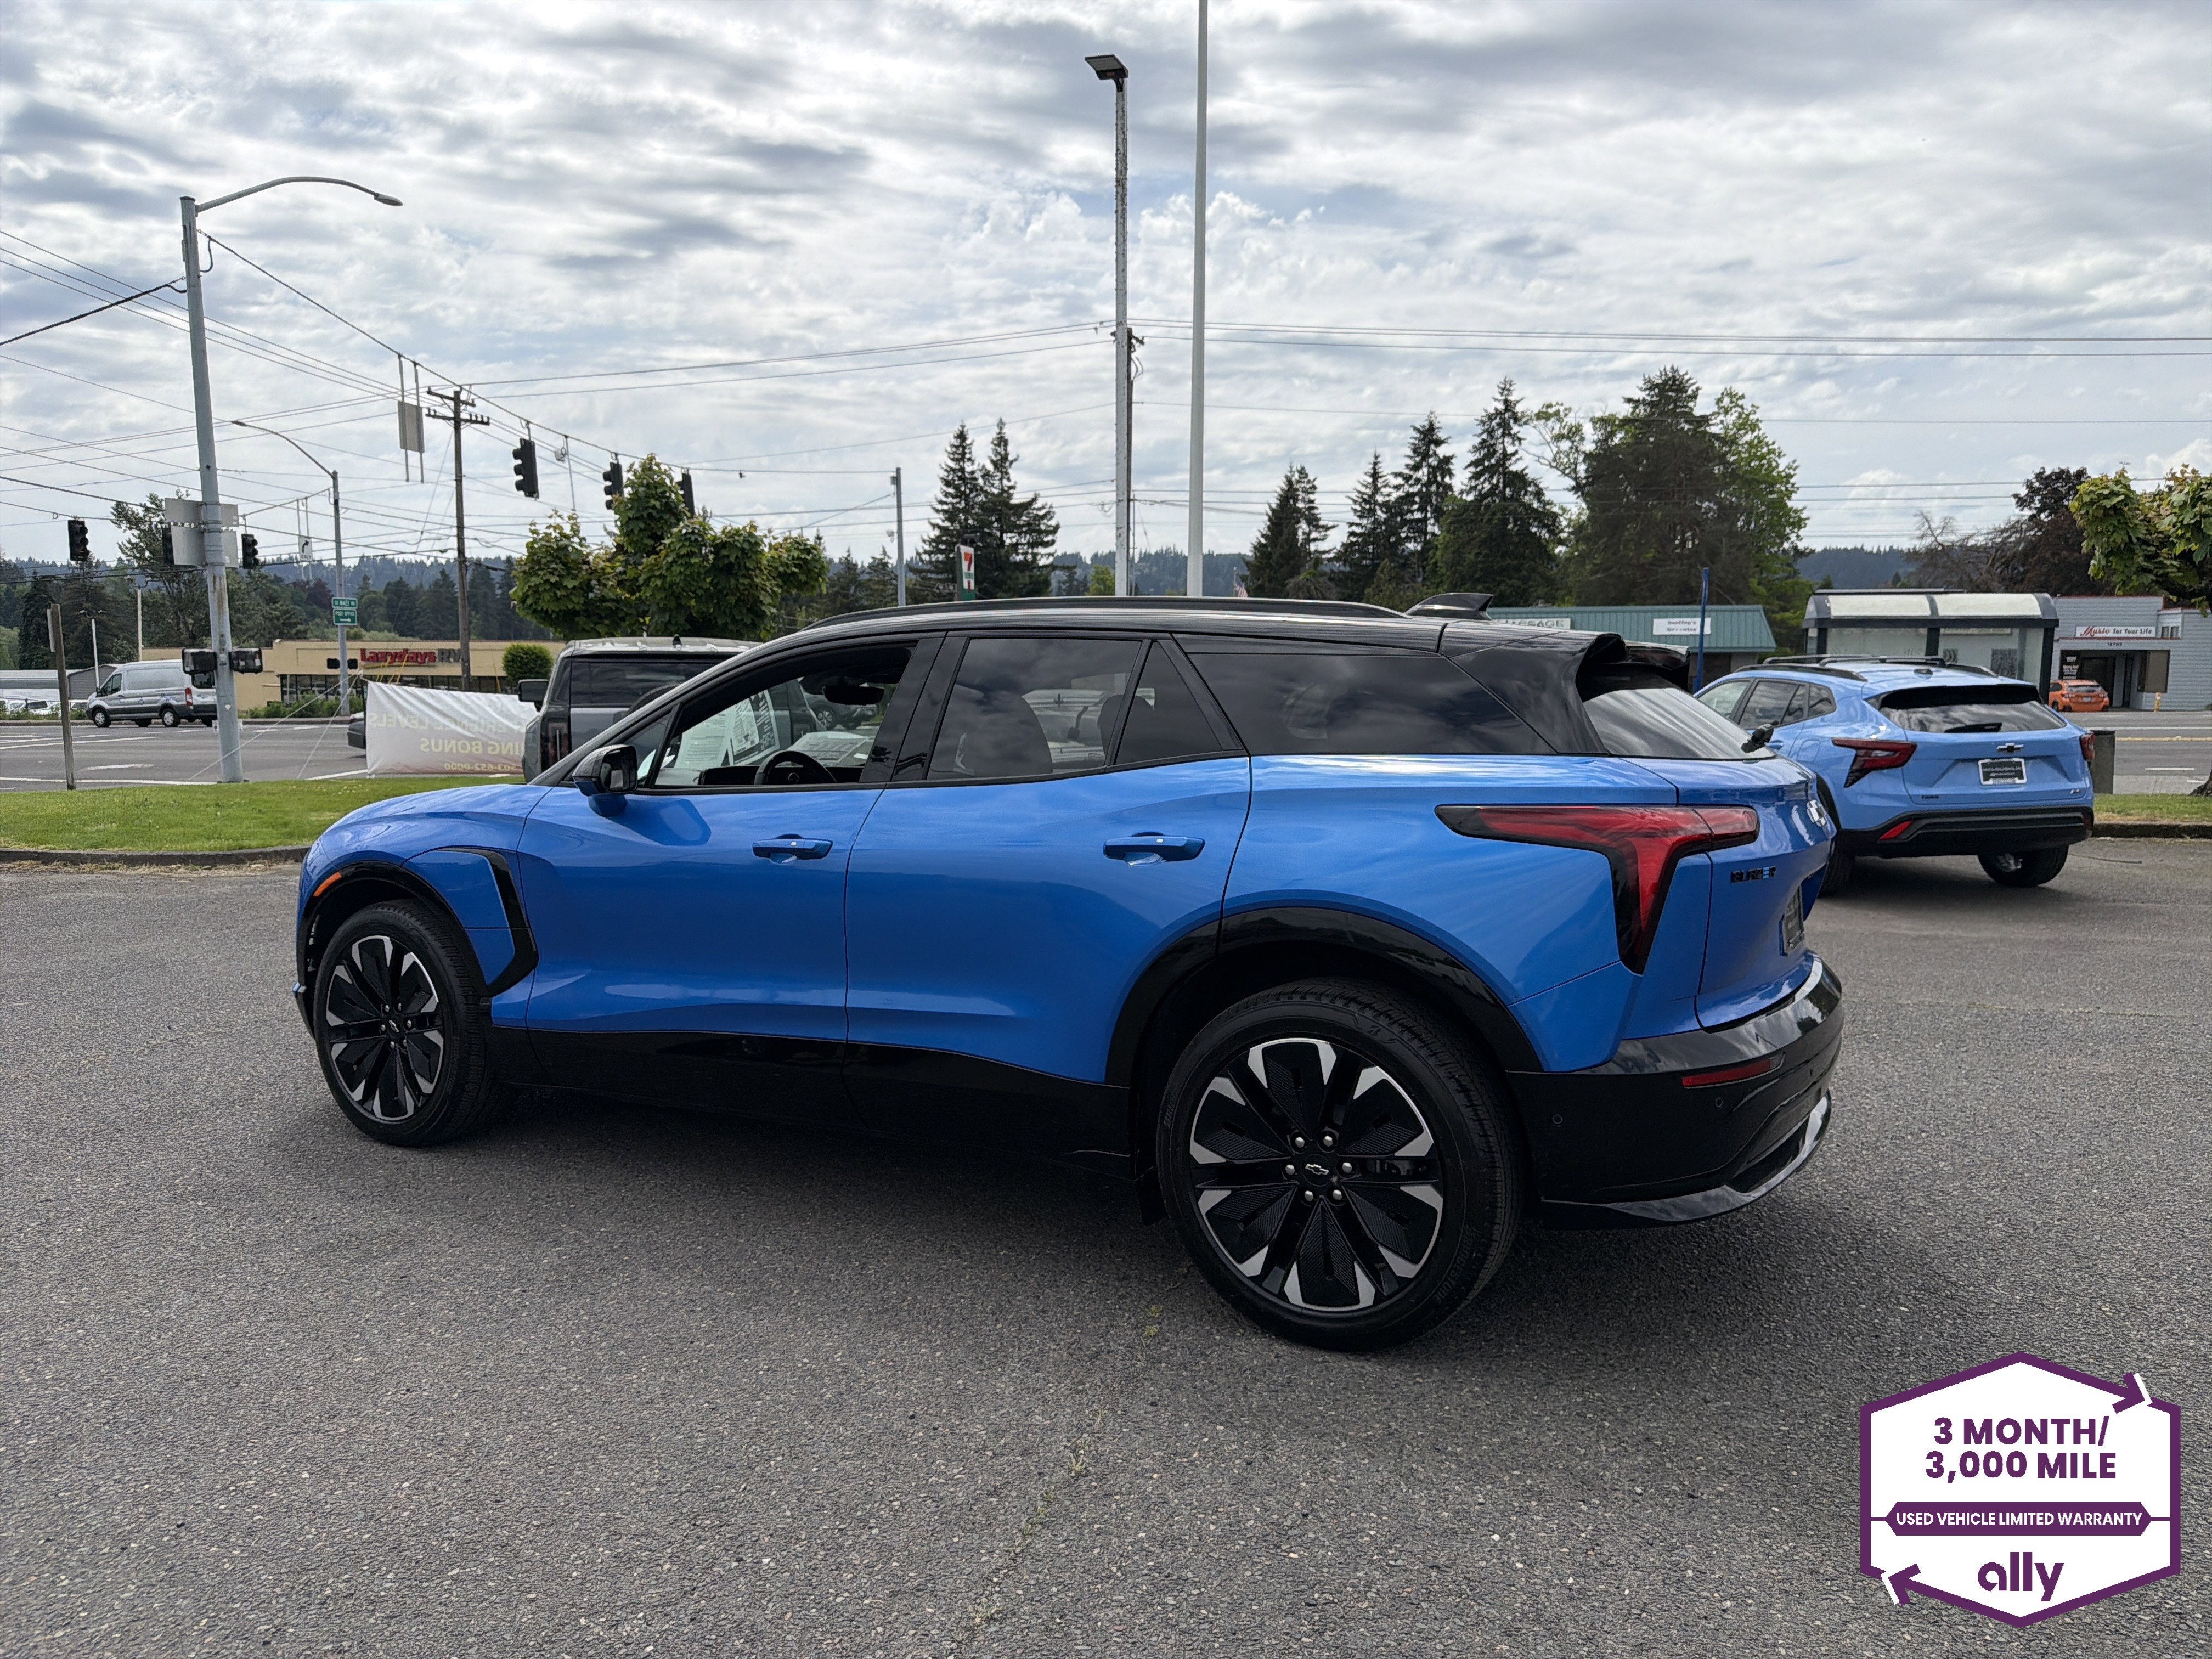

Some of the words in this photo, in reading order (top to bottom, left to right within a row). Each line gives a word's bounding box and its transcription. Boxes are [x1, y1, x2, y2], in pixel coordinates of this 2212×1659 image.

[963, 552, 973, 572] 7
[360, 648, 437, 664] Lazydays
[438, 648, 462, 663] RV
